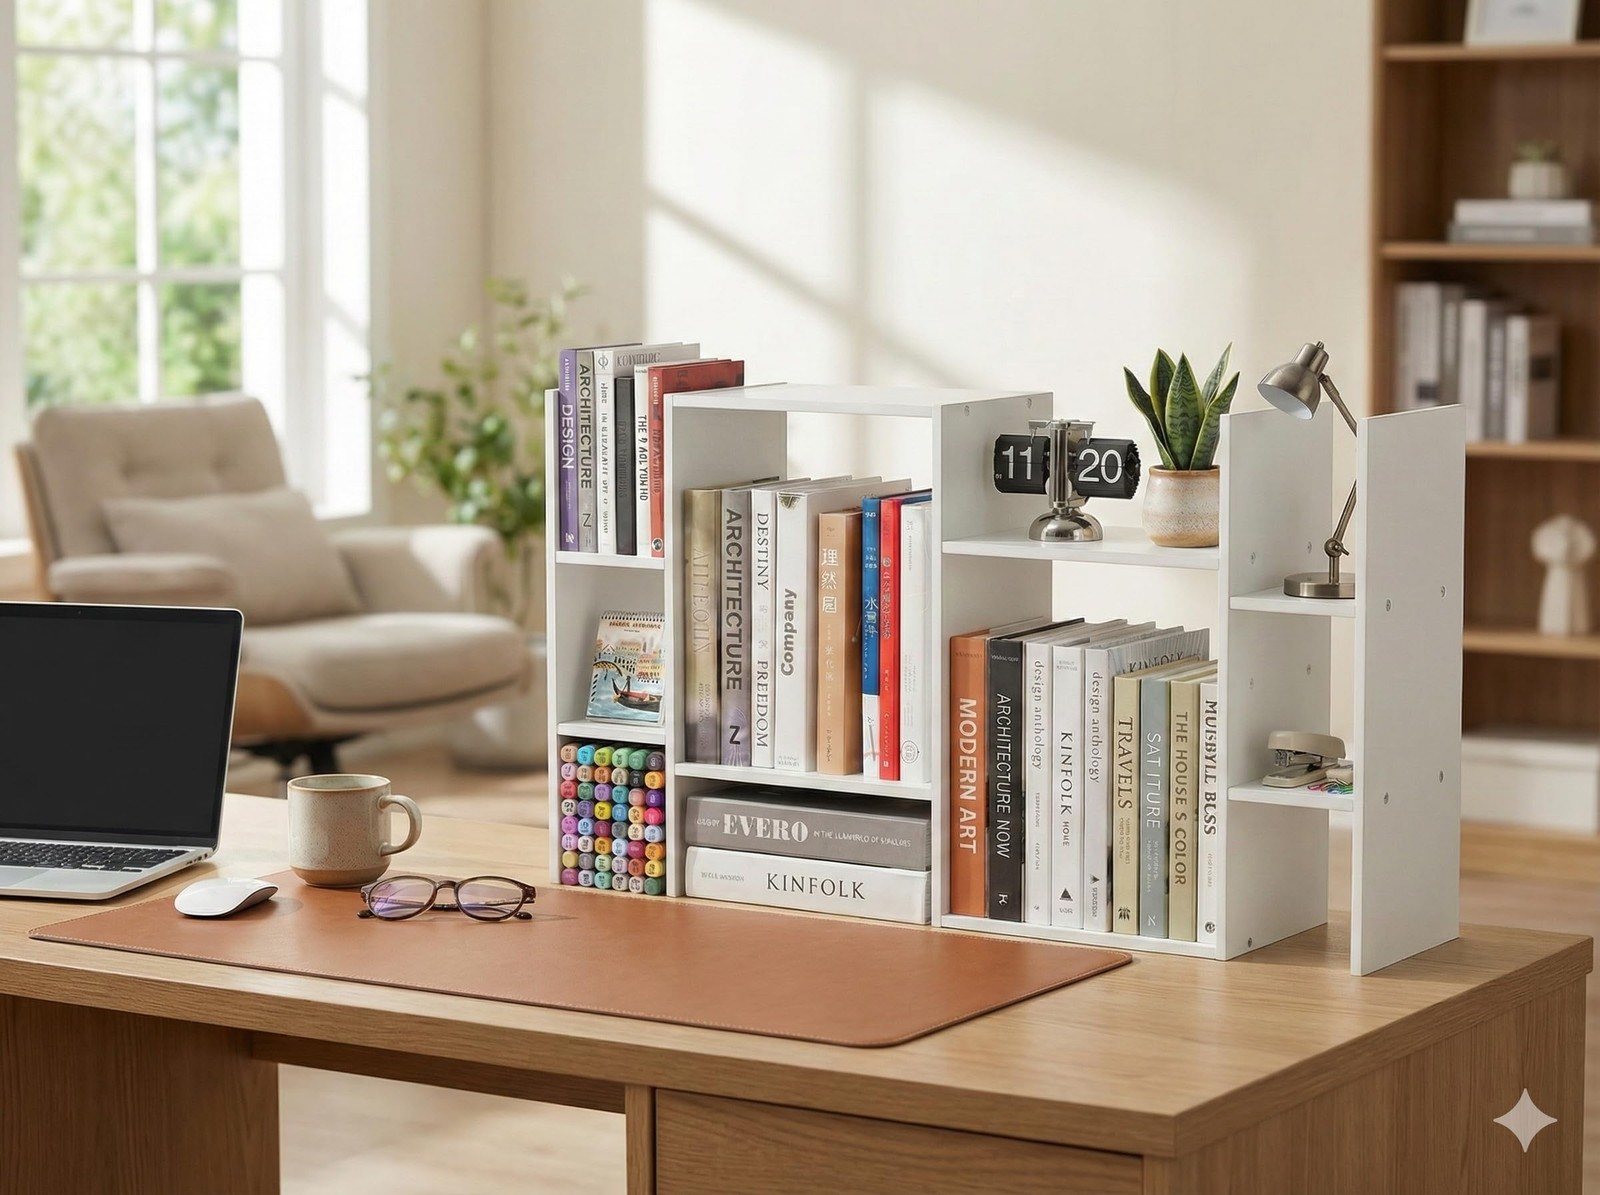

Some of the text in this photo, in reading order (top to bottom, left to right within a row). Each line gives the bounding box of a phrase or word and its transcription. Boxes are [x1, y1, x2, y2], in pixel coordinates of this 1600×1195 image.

[561, 404, 575, 469] DESIGN
[579, 364, 592, 489] ARCHITECTURE
[638, 415, 648, 433] THE
[1002, 445, 1123, 484] 11 20
[757, 513, 769, 591] DESTINY
[726, 508, 742, 690] ARCHITECTURE
[780, 589, 798, 676] Company
[1031, 660, 1045, 770] design anthology
[1088, 671, 1103, 783] design anthology
[1175, 712, 1188, 743] THE
[959, 698, 977, 854] MODERN ART
[996, 693, 1012, 859] ARCHITECTURE NOW
[1060, 731, 1073, 815] KINFOLK
[1118, 716, 1134, 809] TRAVELS
[1175, 749, 1188, 805] HOUSE
[722, 813, 809, 843] EVERO
[1174, 828, 1187, 885] COLOR
[766, 872, 866, 900] KINFOLK
